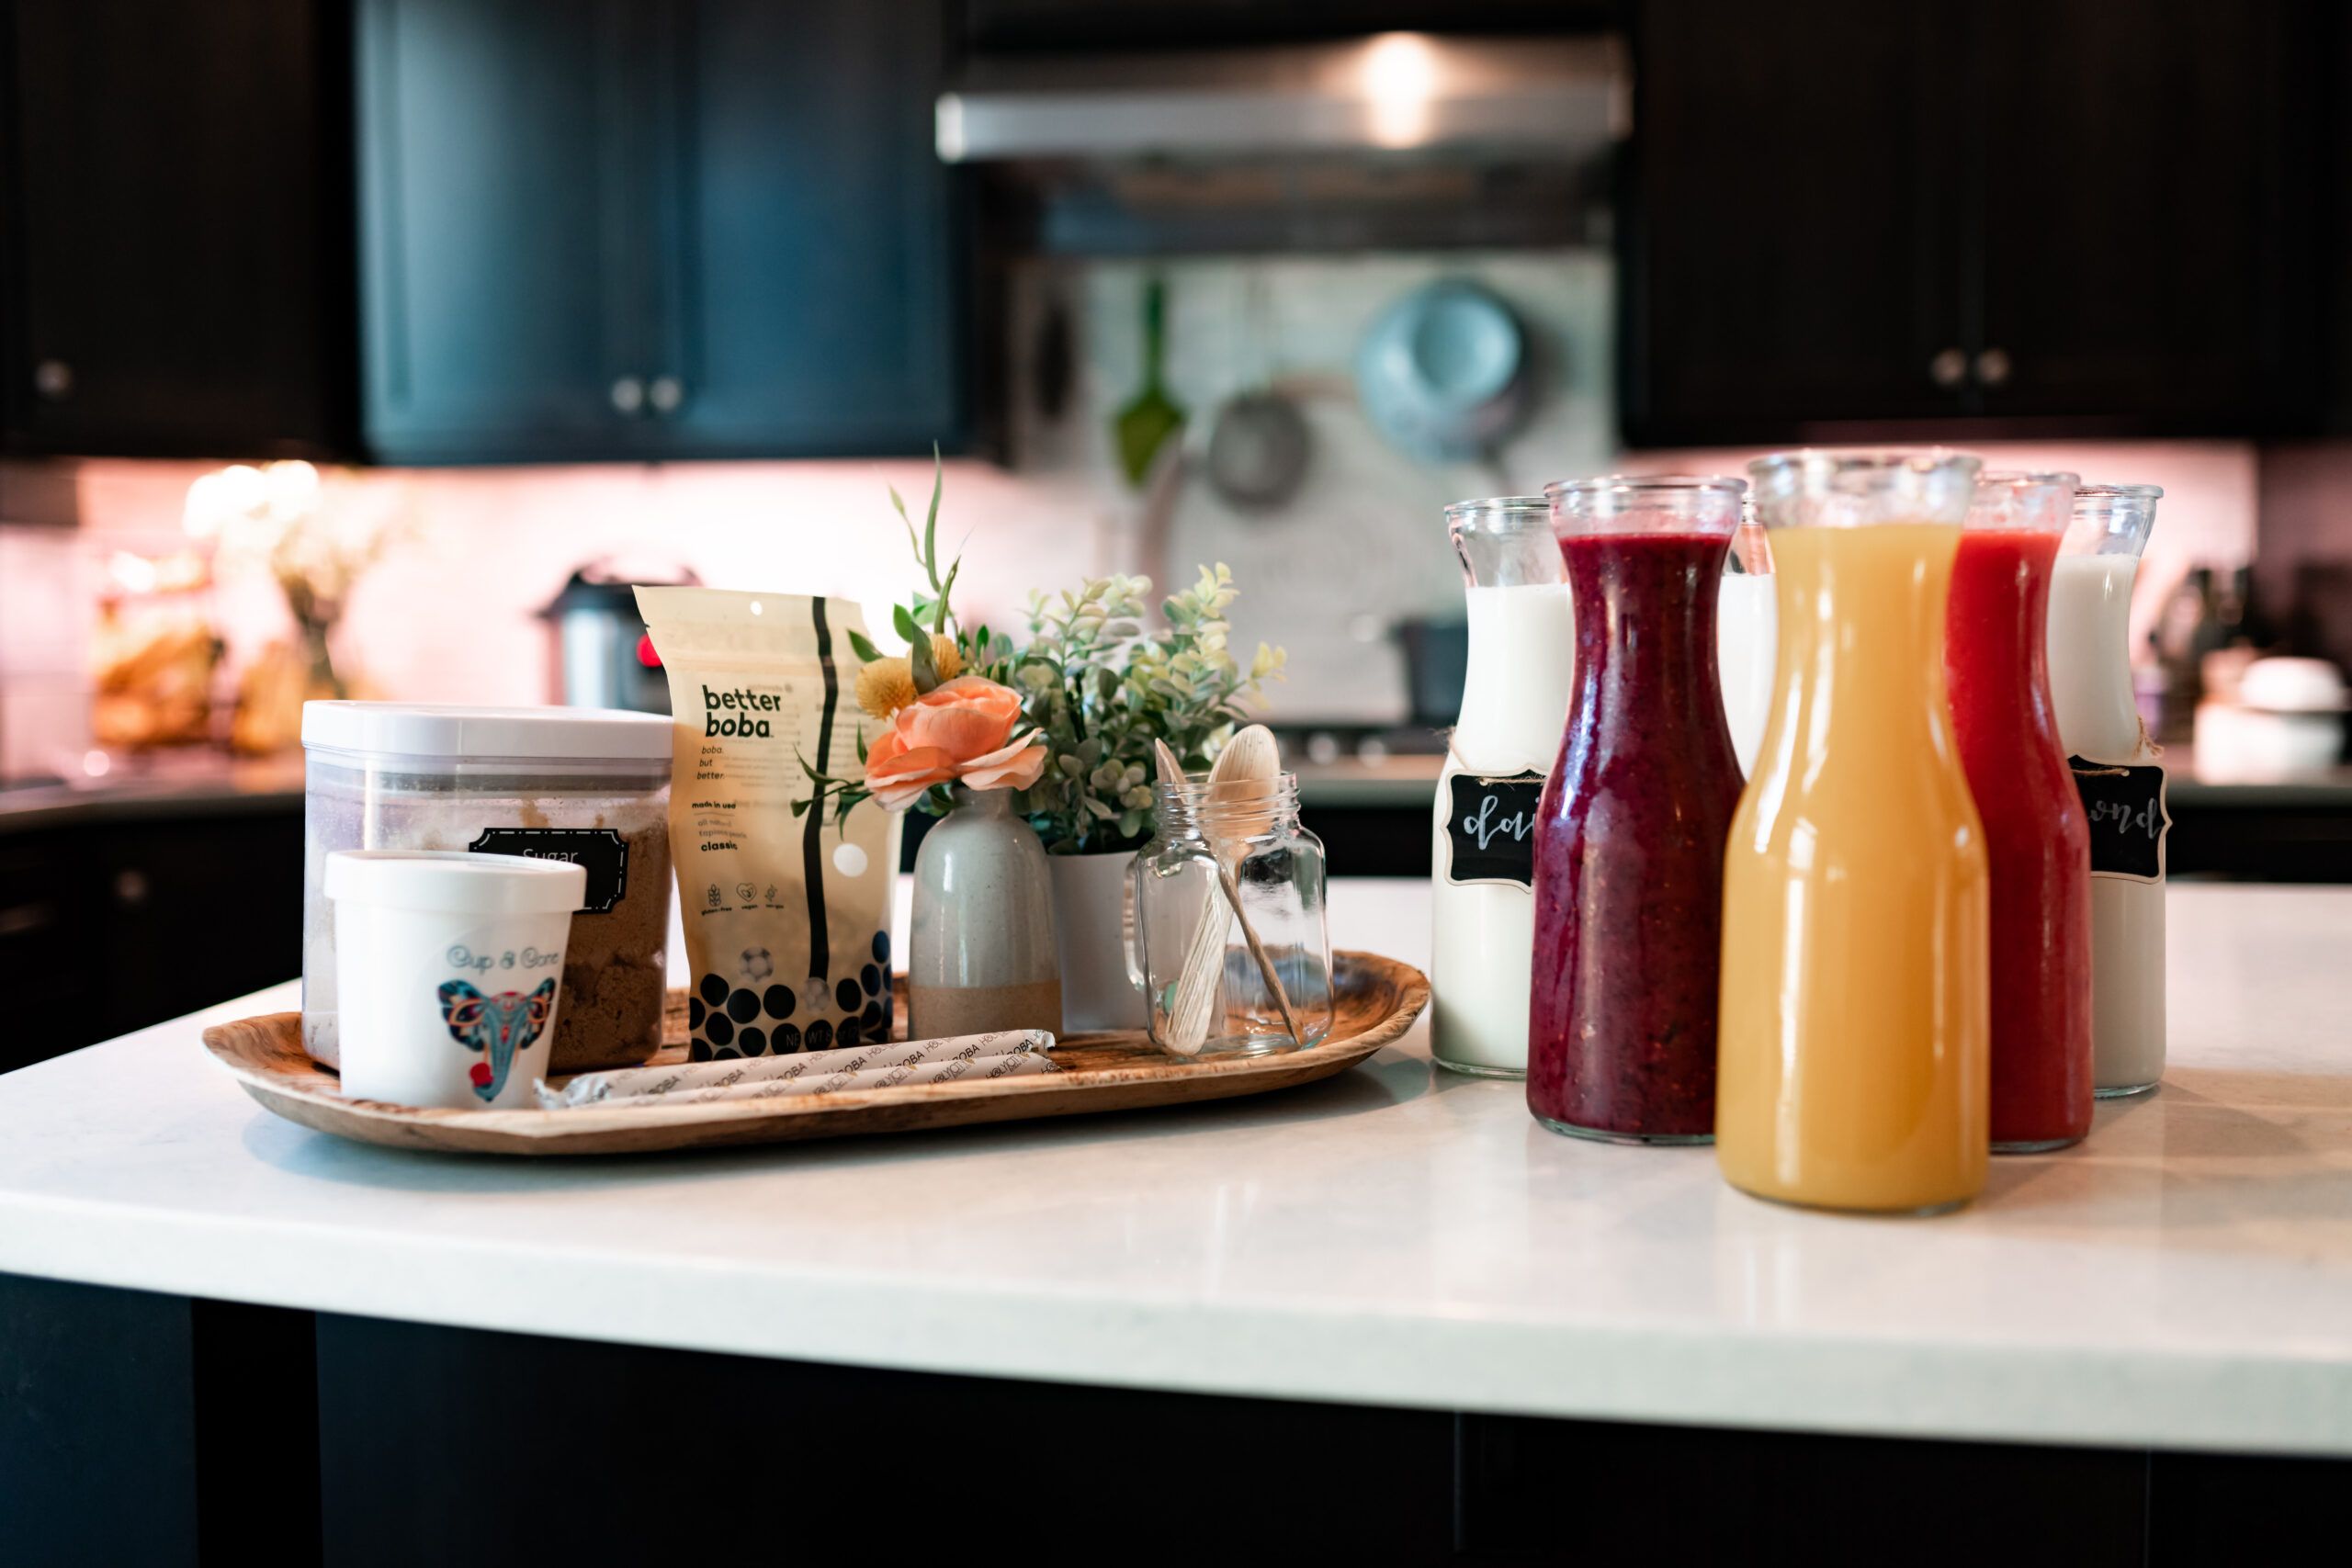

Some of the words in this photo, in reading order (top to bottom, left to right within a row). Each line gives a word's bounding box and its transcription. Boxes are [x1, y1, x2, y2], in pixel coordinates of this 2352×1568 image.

[702, 685, 781, 712] better
[705, 712, 770, 739] boba
[699, 759, 713, 768] but
[2087, 797, 2163, 840] ond
[701, 840, 738, 852] classic
